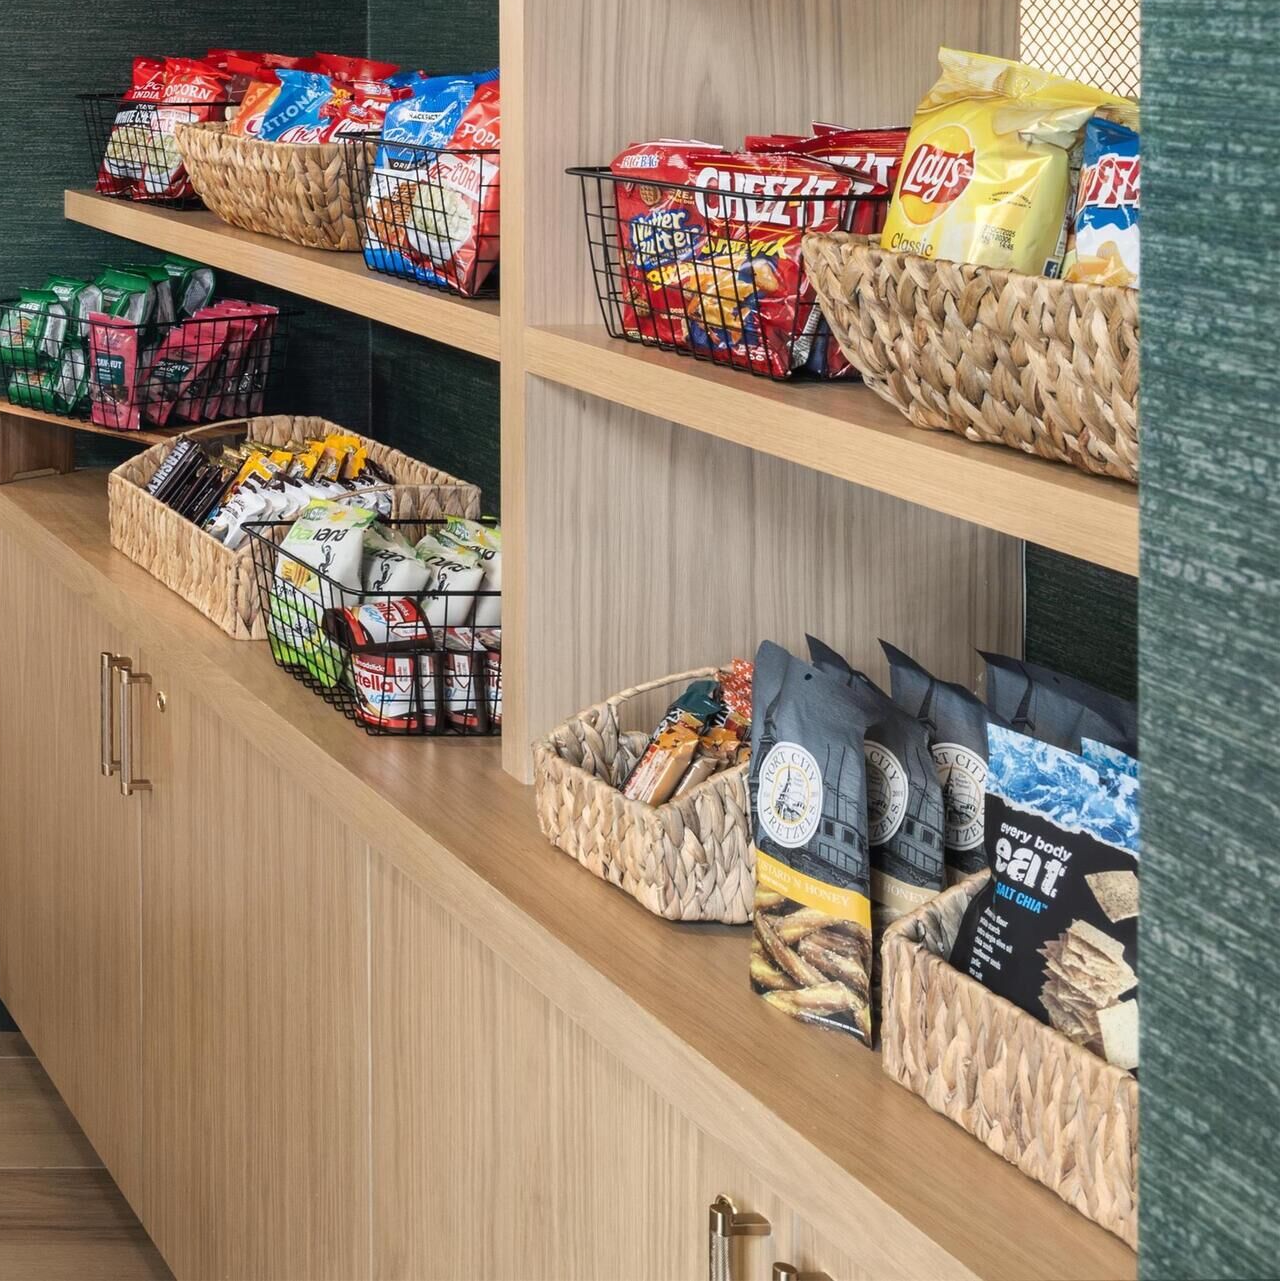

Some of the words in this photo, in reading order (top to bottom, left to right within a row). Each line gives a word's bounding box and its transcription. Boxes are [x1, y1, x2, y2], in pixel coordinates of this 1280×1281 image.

[277, 124, 329, 144] Chex
[622, 156, 640, 167] BIG
[640, 155, 659, 167] BAG
[903, 145, 974, 204] Lay's
[695, 166, 837, 228] CHEEZ-IT
[633, 209, 686, 241] Nutter
[890, 232, 933, 257] Classic
[765, 750, 787, 784] PORT
[791, 751, 817, 782] CITY
[870, 750, 901, 782] CITY
[764, 804, 816, 840] PRETZELS
[1000, 822, 1033, 845] every
[1035, 835, 1073, 863] body
[804, 884, 850, 906] HONEY
[995, 881, 1017, 903] SALT
